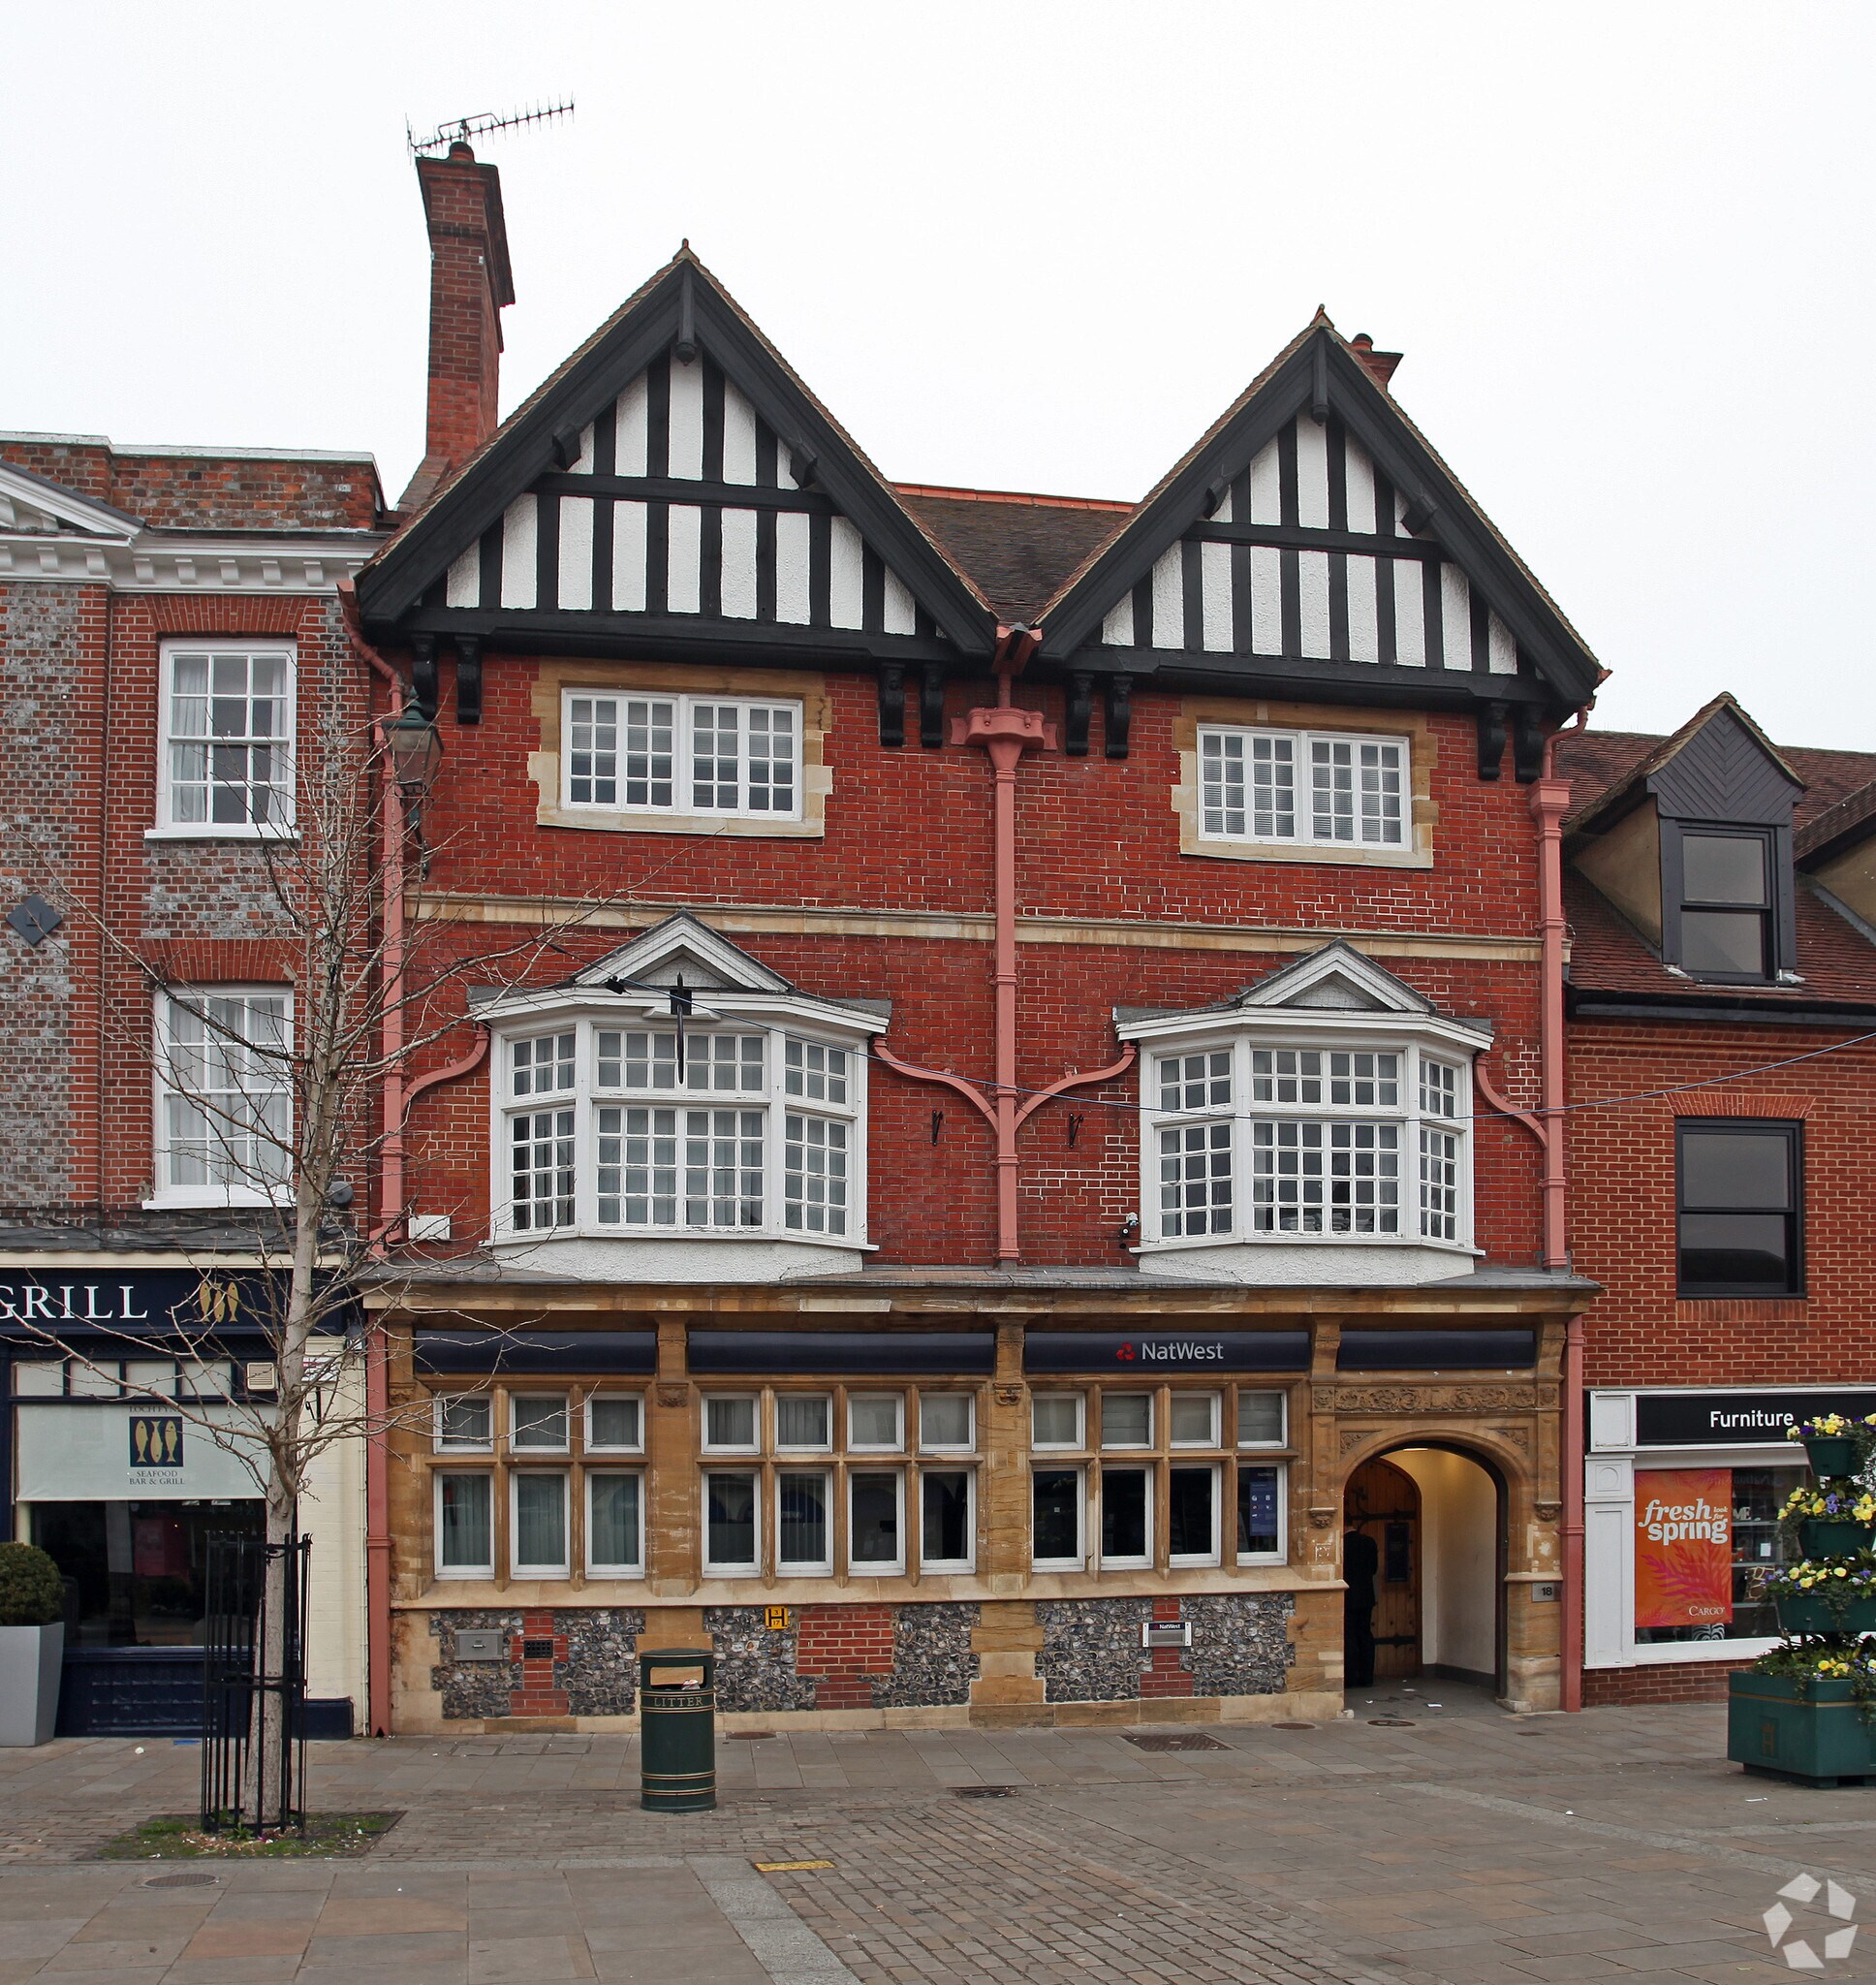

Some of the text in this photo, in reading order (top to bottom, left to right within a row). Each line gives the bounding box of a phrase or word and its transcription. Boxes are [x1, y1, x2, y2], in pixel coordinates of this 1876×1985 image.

[0, 1285, 148, 1319] GRILL
[1141, 1341, 1224, 1360] NatWest
[1709, 1409, 1794, 1428] Furniture
[1638, 1497, 1712, 1528] fresh
[1647, 1518, 1729, 1546] spring
[1541, 1586, 1552, 1596] 18
[654, 1697, 704, 1707] LITTER
